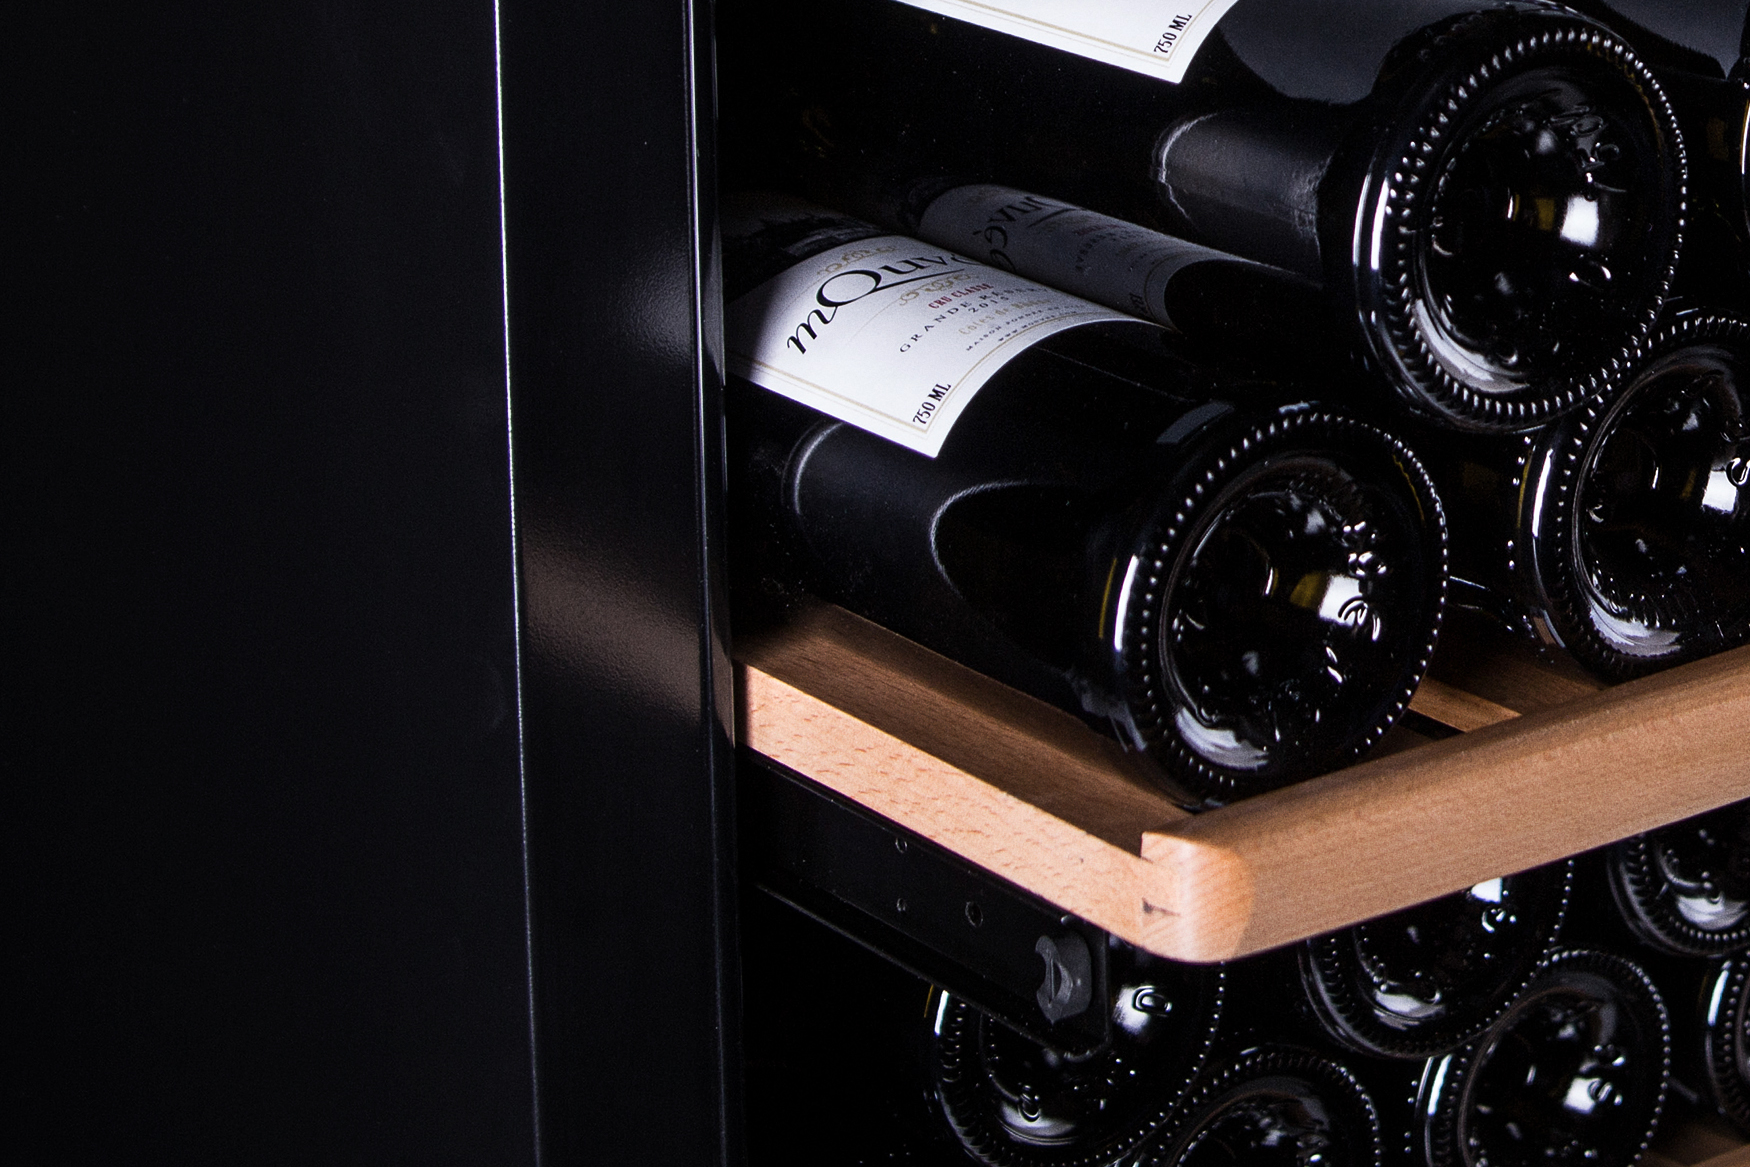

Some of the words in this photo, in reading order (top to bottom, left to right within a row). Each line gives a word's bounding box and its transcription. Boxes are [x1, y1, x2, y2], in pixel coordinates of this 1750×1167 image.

[1153, 31, 1177, 54] 750
[1175, 12, 1193, 33] ML
[927, 295, 953, 310] CRU
[967, 295, 1010, 314] 2015
[899, 300, 972, 354] GRANDE
[966, 325, 1002, 352] MAISON
[912, 400, 936, 425] 750
[928, 381, 953, 404] ML
